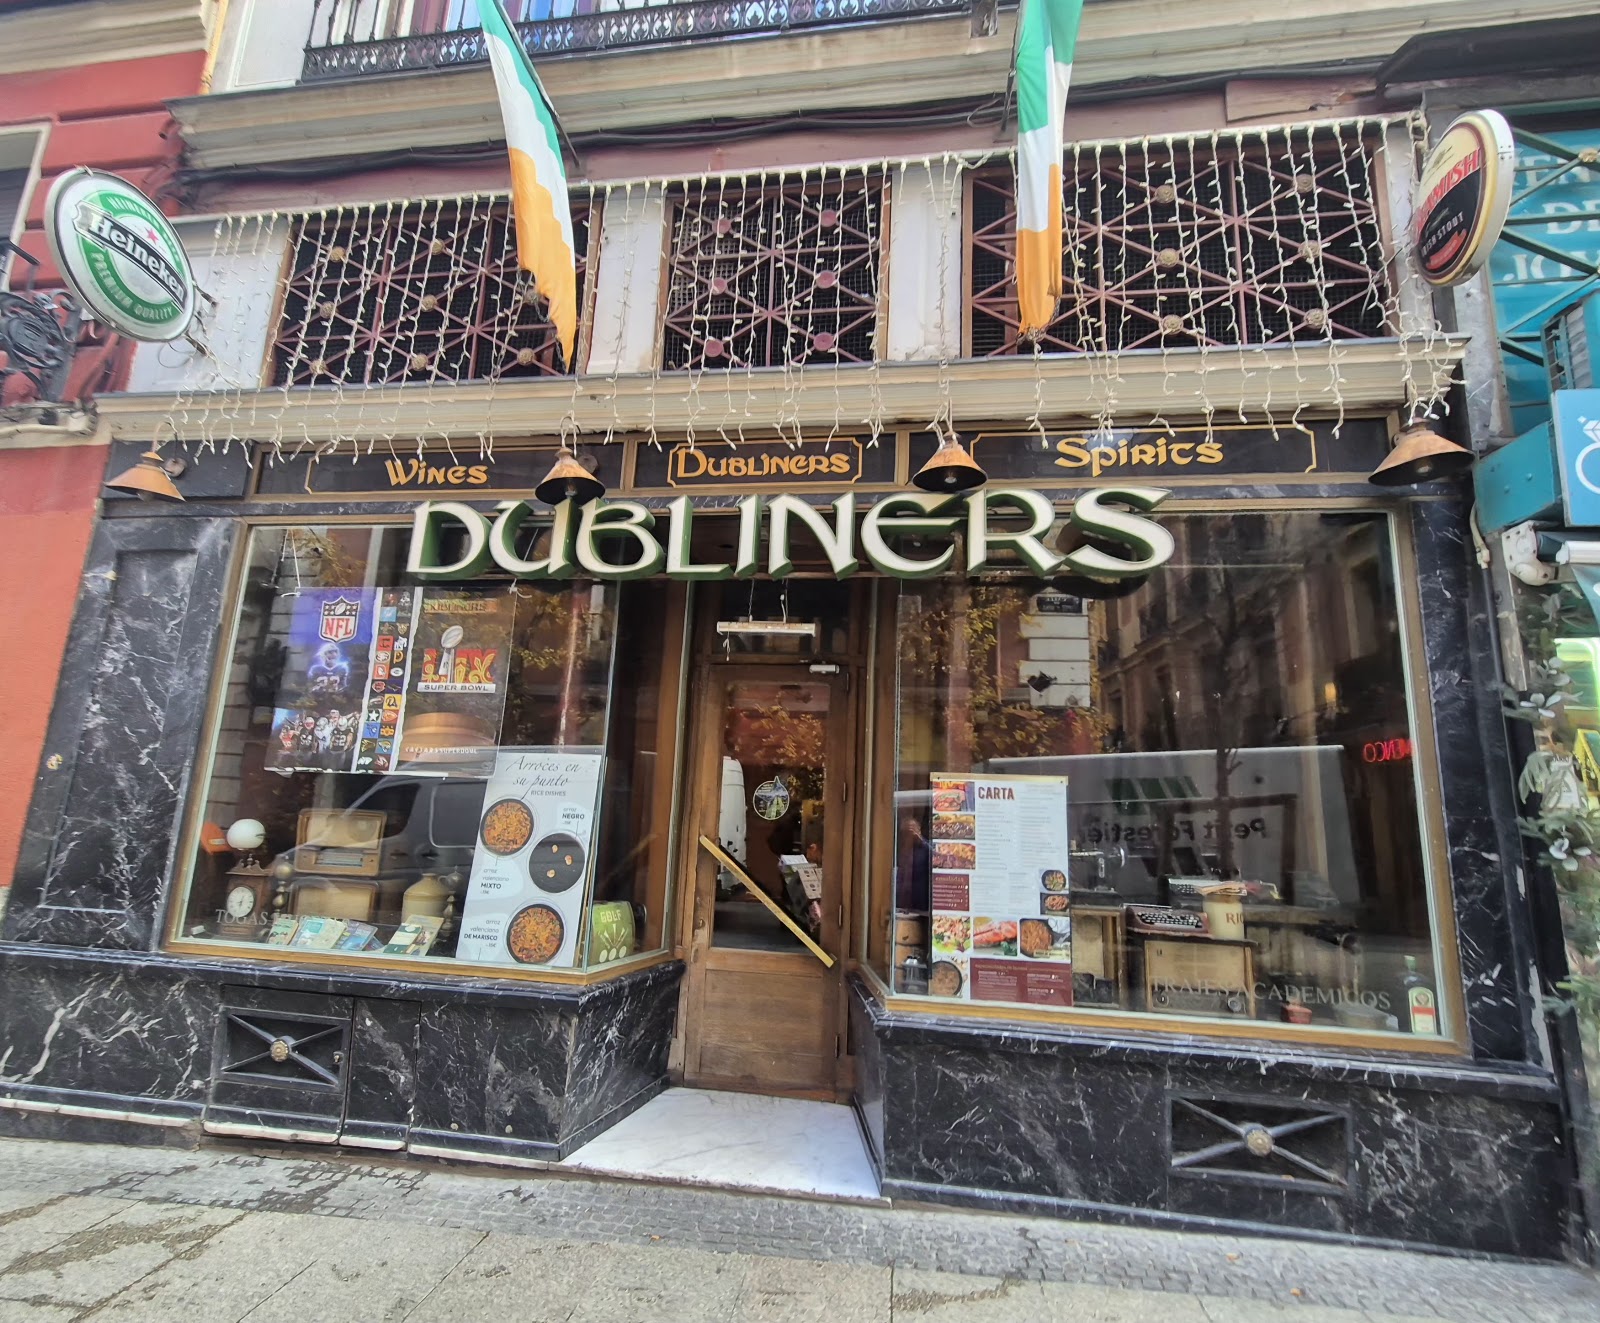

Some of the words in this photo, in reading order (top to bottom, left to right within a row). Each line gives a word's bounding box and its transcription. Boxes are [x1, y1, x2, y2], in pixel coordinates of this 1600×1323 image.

[89, 211, 186, 303] Heineken
[90, 252, 134, 308] PREMIUM
[134, 301, 173, 320] QUALITY
[405, 486, 1176, 581] DUBLINERS
[323, 617, 353, 639] NFL
[460, 684, 489, 692] BOWL
[506, 755, 560, 773] Arroces
[565, 762, 582, 773] en
[512, 777, 529, 786] su
[529, 773, 573, 788] punto
[978, 786, 1015, 801] CARTA
[562, 812, 585, 821] NEGRO
[480, 882, 502, 890] MIXTO
[215, 909, 269, 926] TOGAS
[600, 909, 622, 923] GOLF
[469, 926, 499, 934] valenciano
[472, 933, 498, 941] MARISCO
